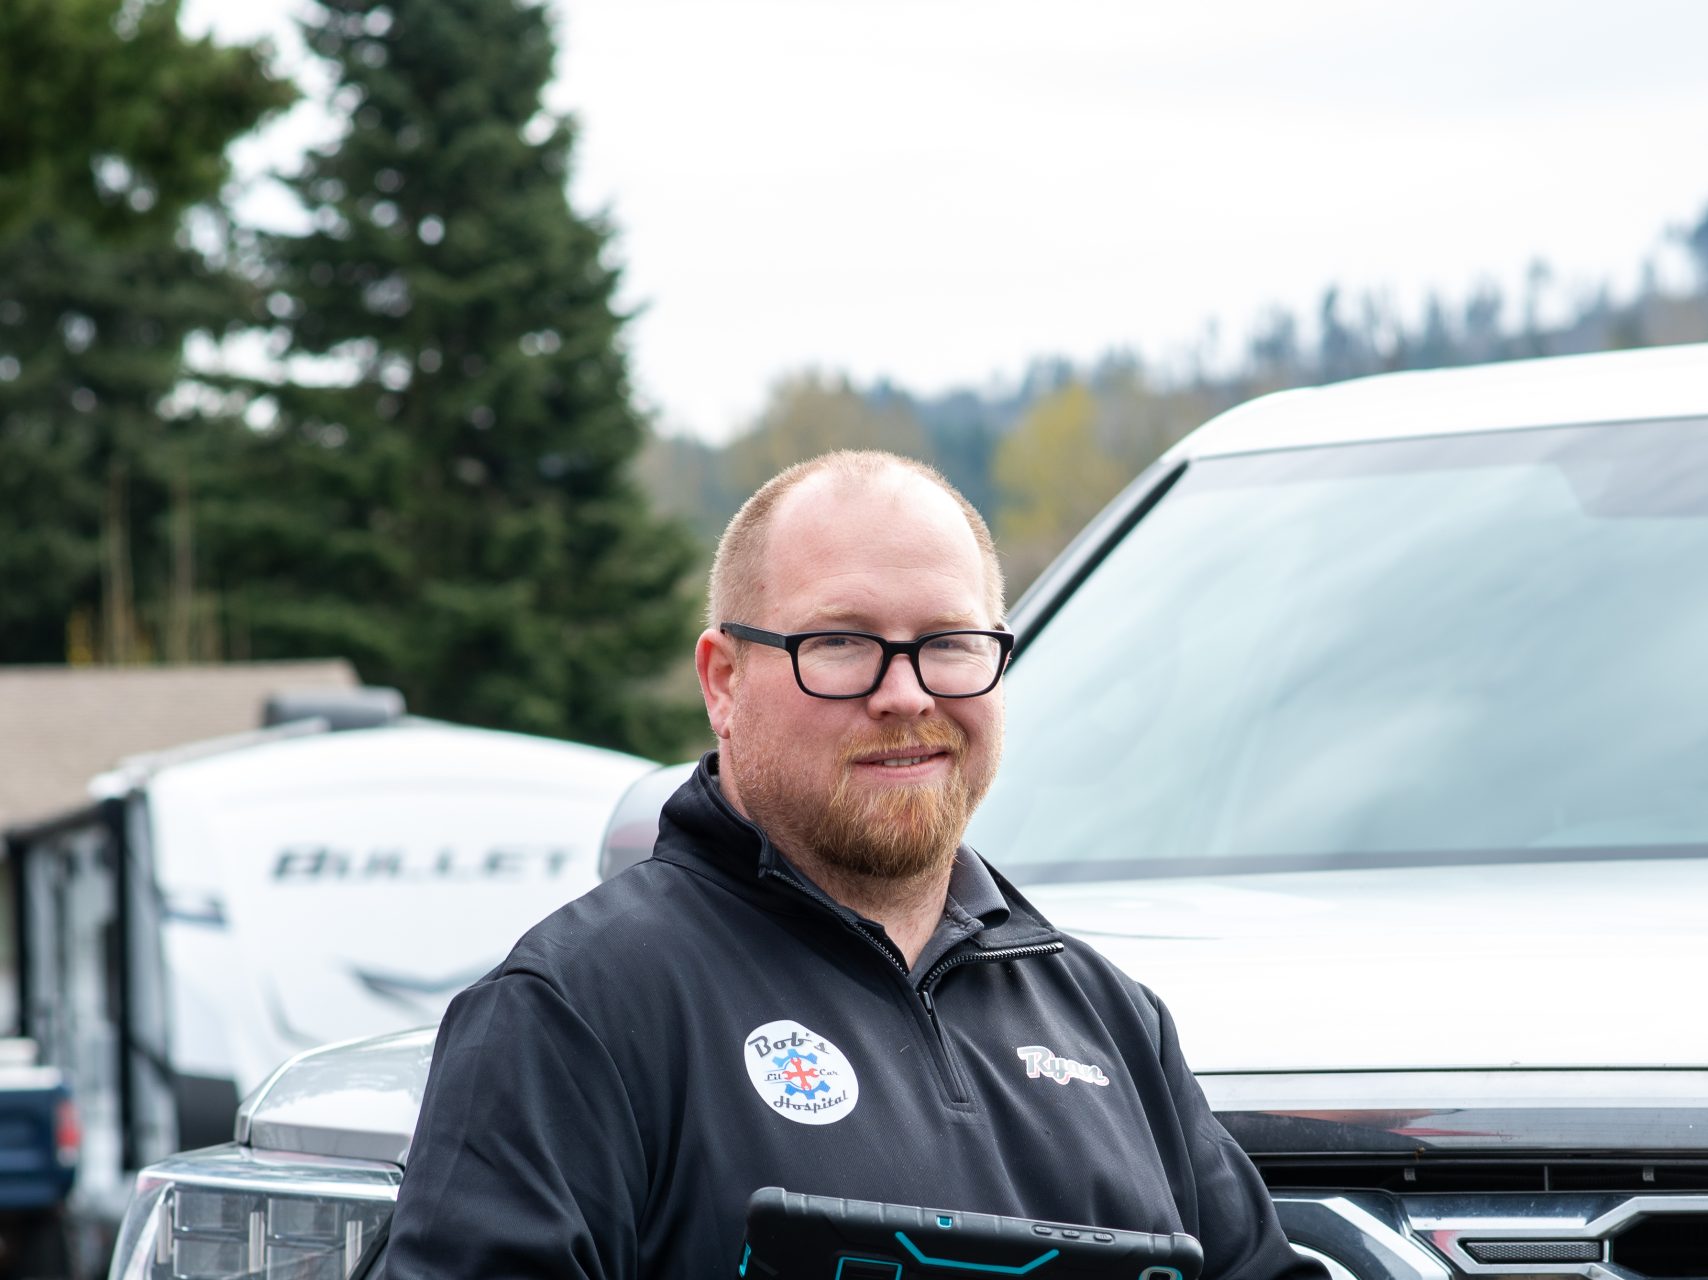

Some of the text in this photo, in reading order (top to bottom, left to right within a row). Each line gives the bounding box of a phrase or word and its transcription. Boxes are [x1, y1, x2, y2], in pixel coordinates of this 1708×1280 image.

[748, 1031, 830, 1058] Bob's
[1017, 1045, 1109, 1086] Ryan
[773, 1090, 848, 1113] Hospital
